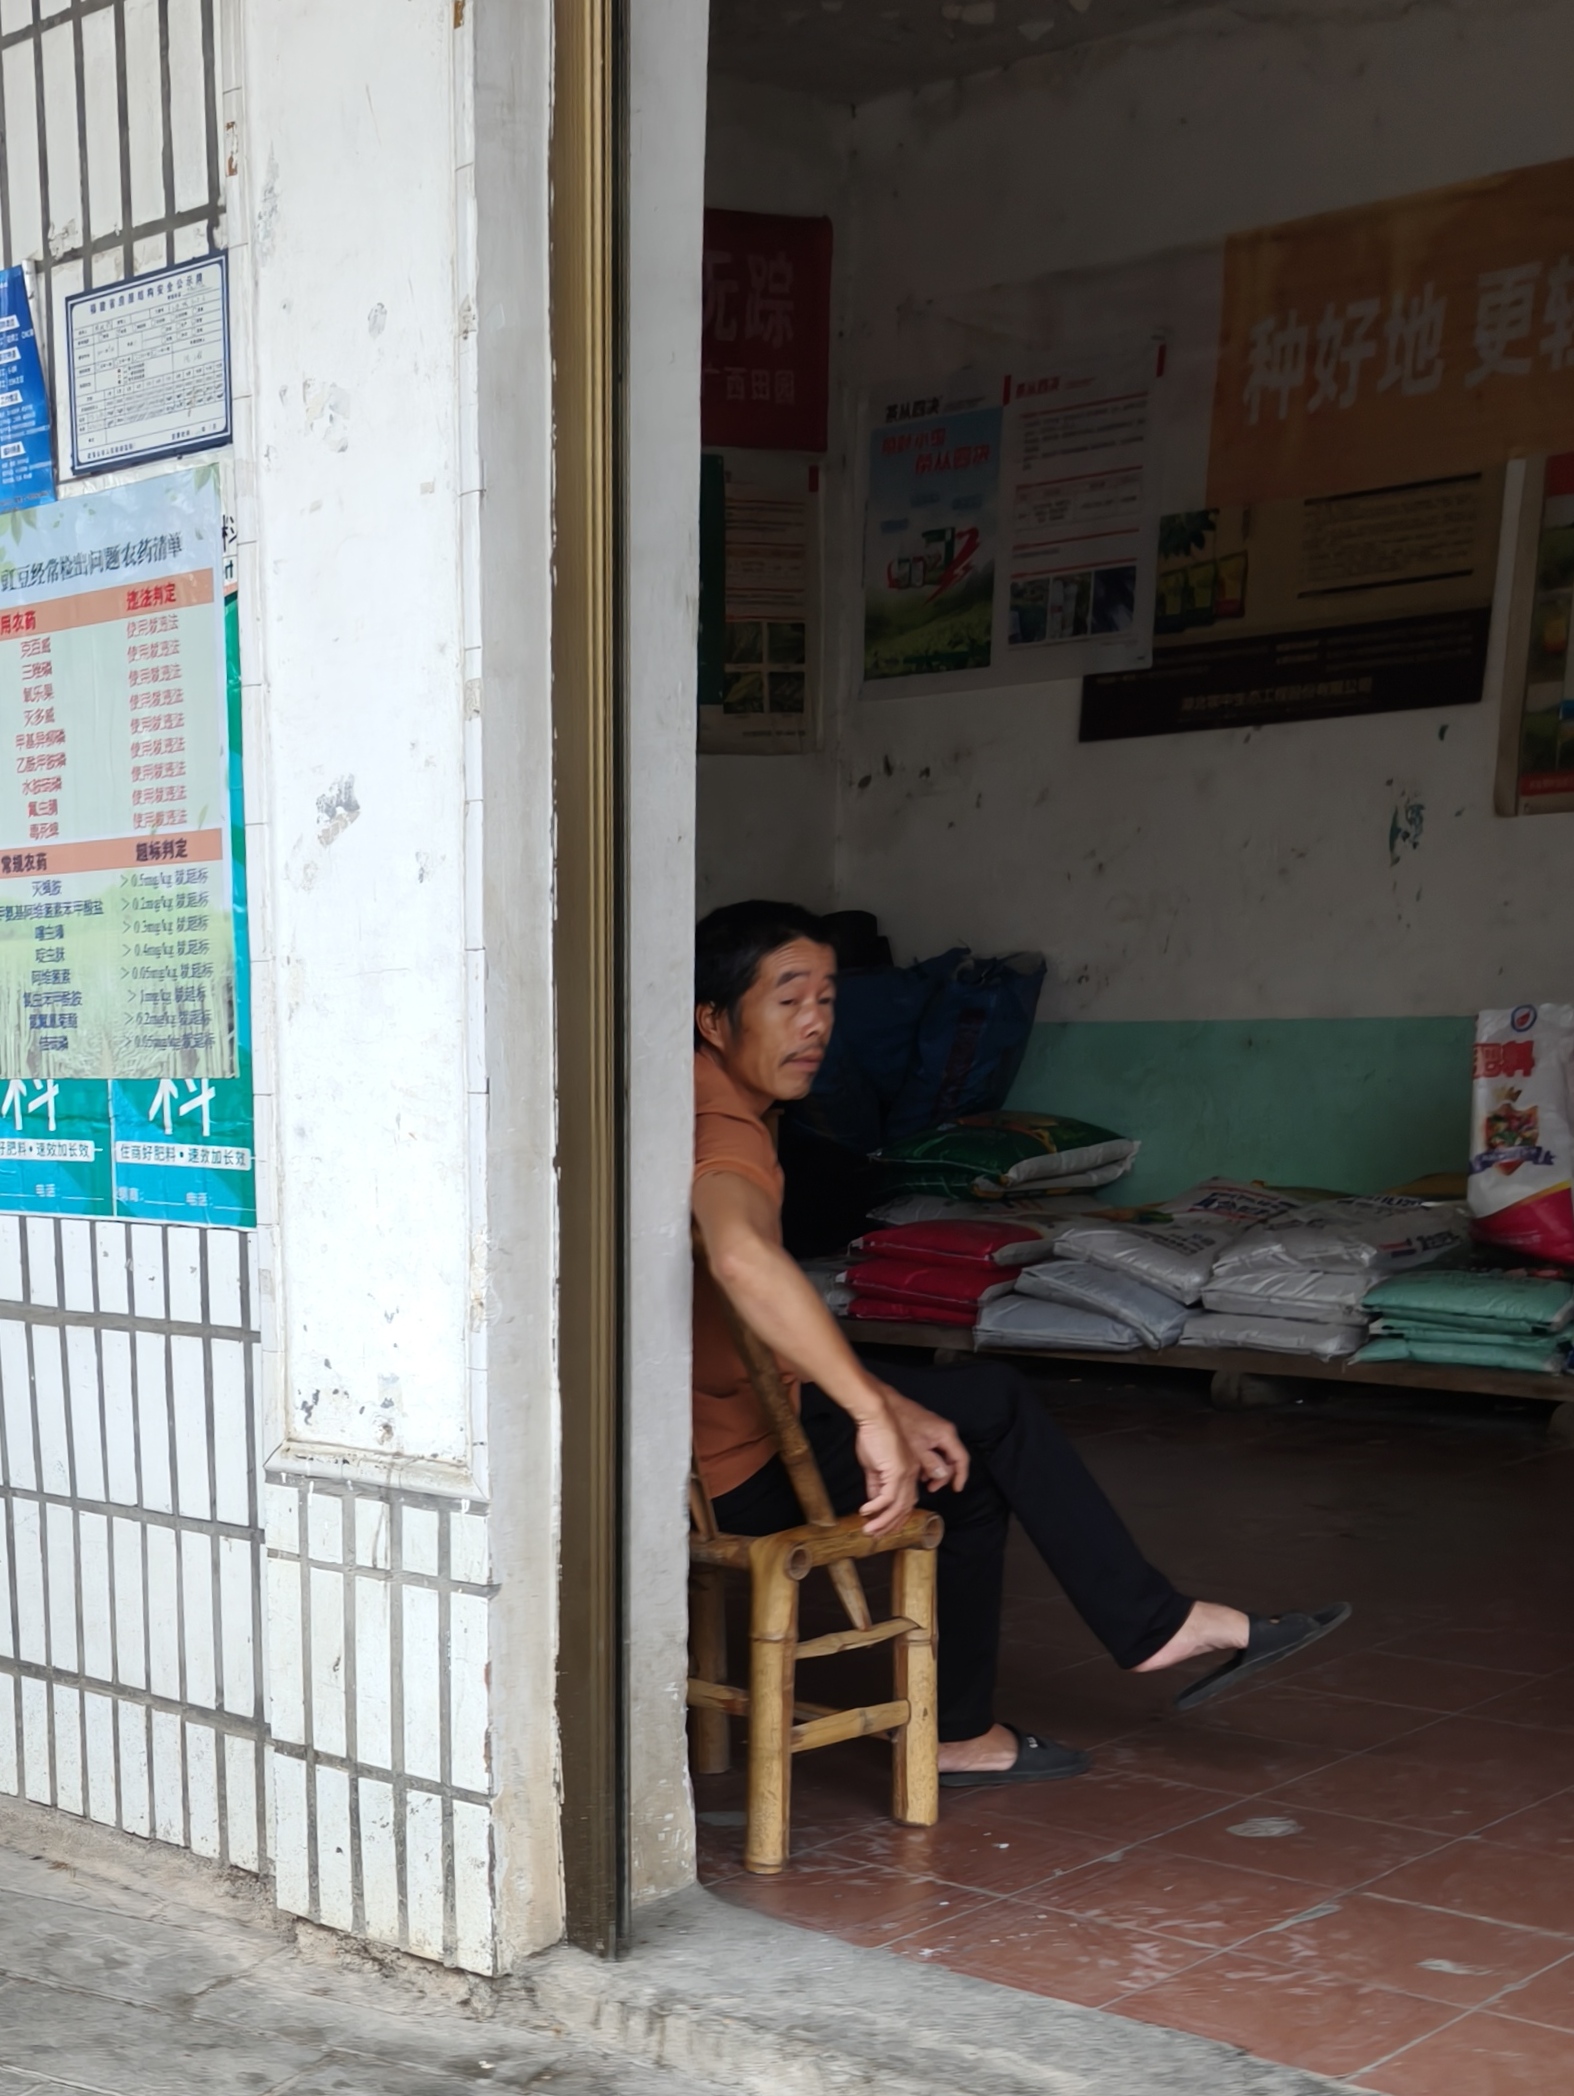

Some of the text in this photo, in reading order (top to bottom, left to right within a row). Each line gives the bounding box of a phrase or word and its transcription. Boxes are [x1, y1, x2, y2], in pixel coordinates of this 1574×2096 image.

[1242, 280, 1449, 427] 种好地
[0, 529, 183, 592] 豇豆经常检出问题农药清单
[126, 582, 177, 611] 违法判定
[0, 609, 36, 635] 用农药
[126, 614, 179, 638] 使用就违法
[20, 636, 51, 659] 克百威
[127, 639, 180, 663] 使用就违法
[22, 660, 52, 680] 三唑磷
[128, 662, 182, 687] 使用就违法
[23, 683, 55, 703] 氧乐果
[129, 687, 185, 711] 使用就违法
[23, 706, 55, 727] 灭多威
[130, 712, 185, 735] 使用就违法
[130, 736, 186, 759] 使用就违法
[17, 752, 66, 773] 乙酰甲胺磷
[131, 761, 186, 783] 使用就违法
[22, 776, 62, 796] 水胺硫磷
[132, 784, 188, 806] 使用就违法
[28, 799, 58, 817] 氟虫腈
[133, 808, 188, 830] 使用就违法
[29, 821, 59, 841] 毒死蜱
[136, 838, 188, 862] 超标判定
[1, 852, 47, 874] 常规农药
[31, 880, 62, 898] 灭蝇胺
[31, 968, 71, 986] 阿维菌素
[1472, 1041, 1536, 1079] 肥料
